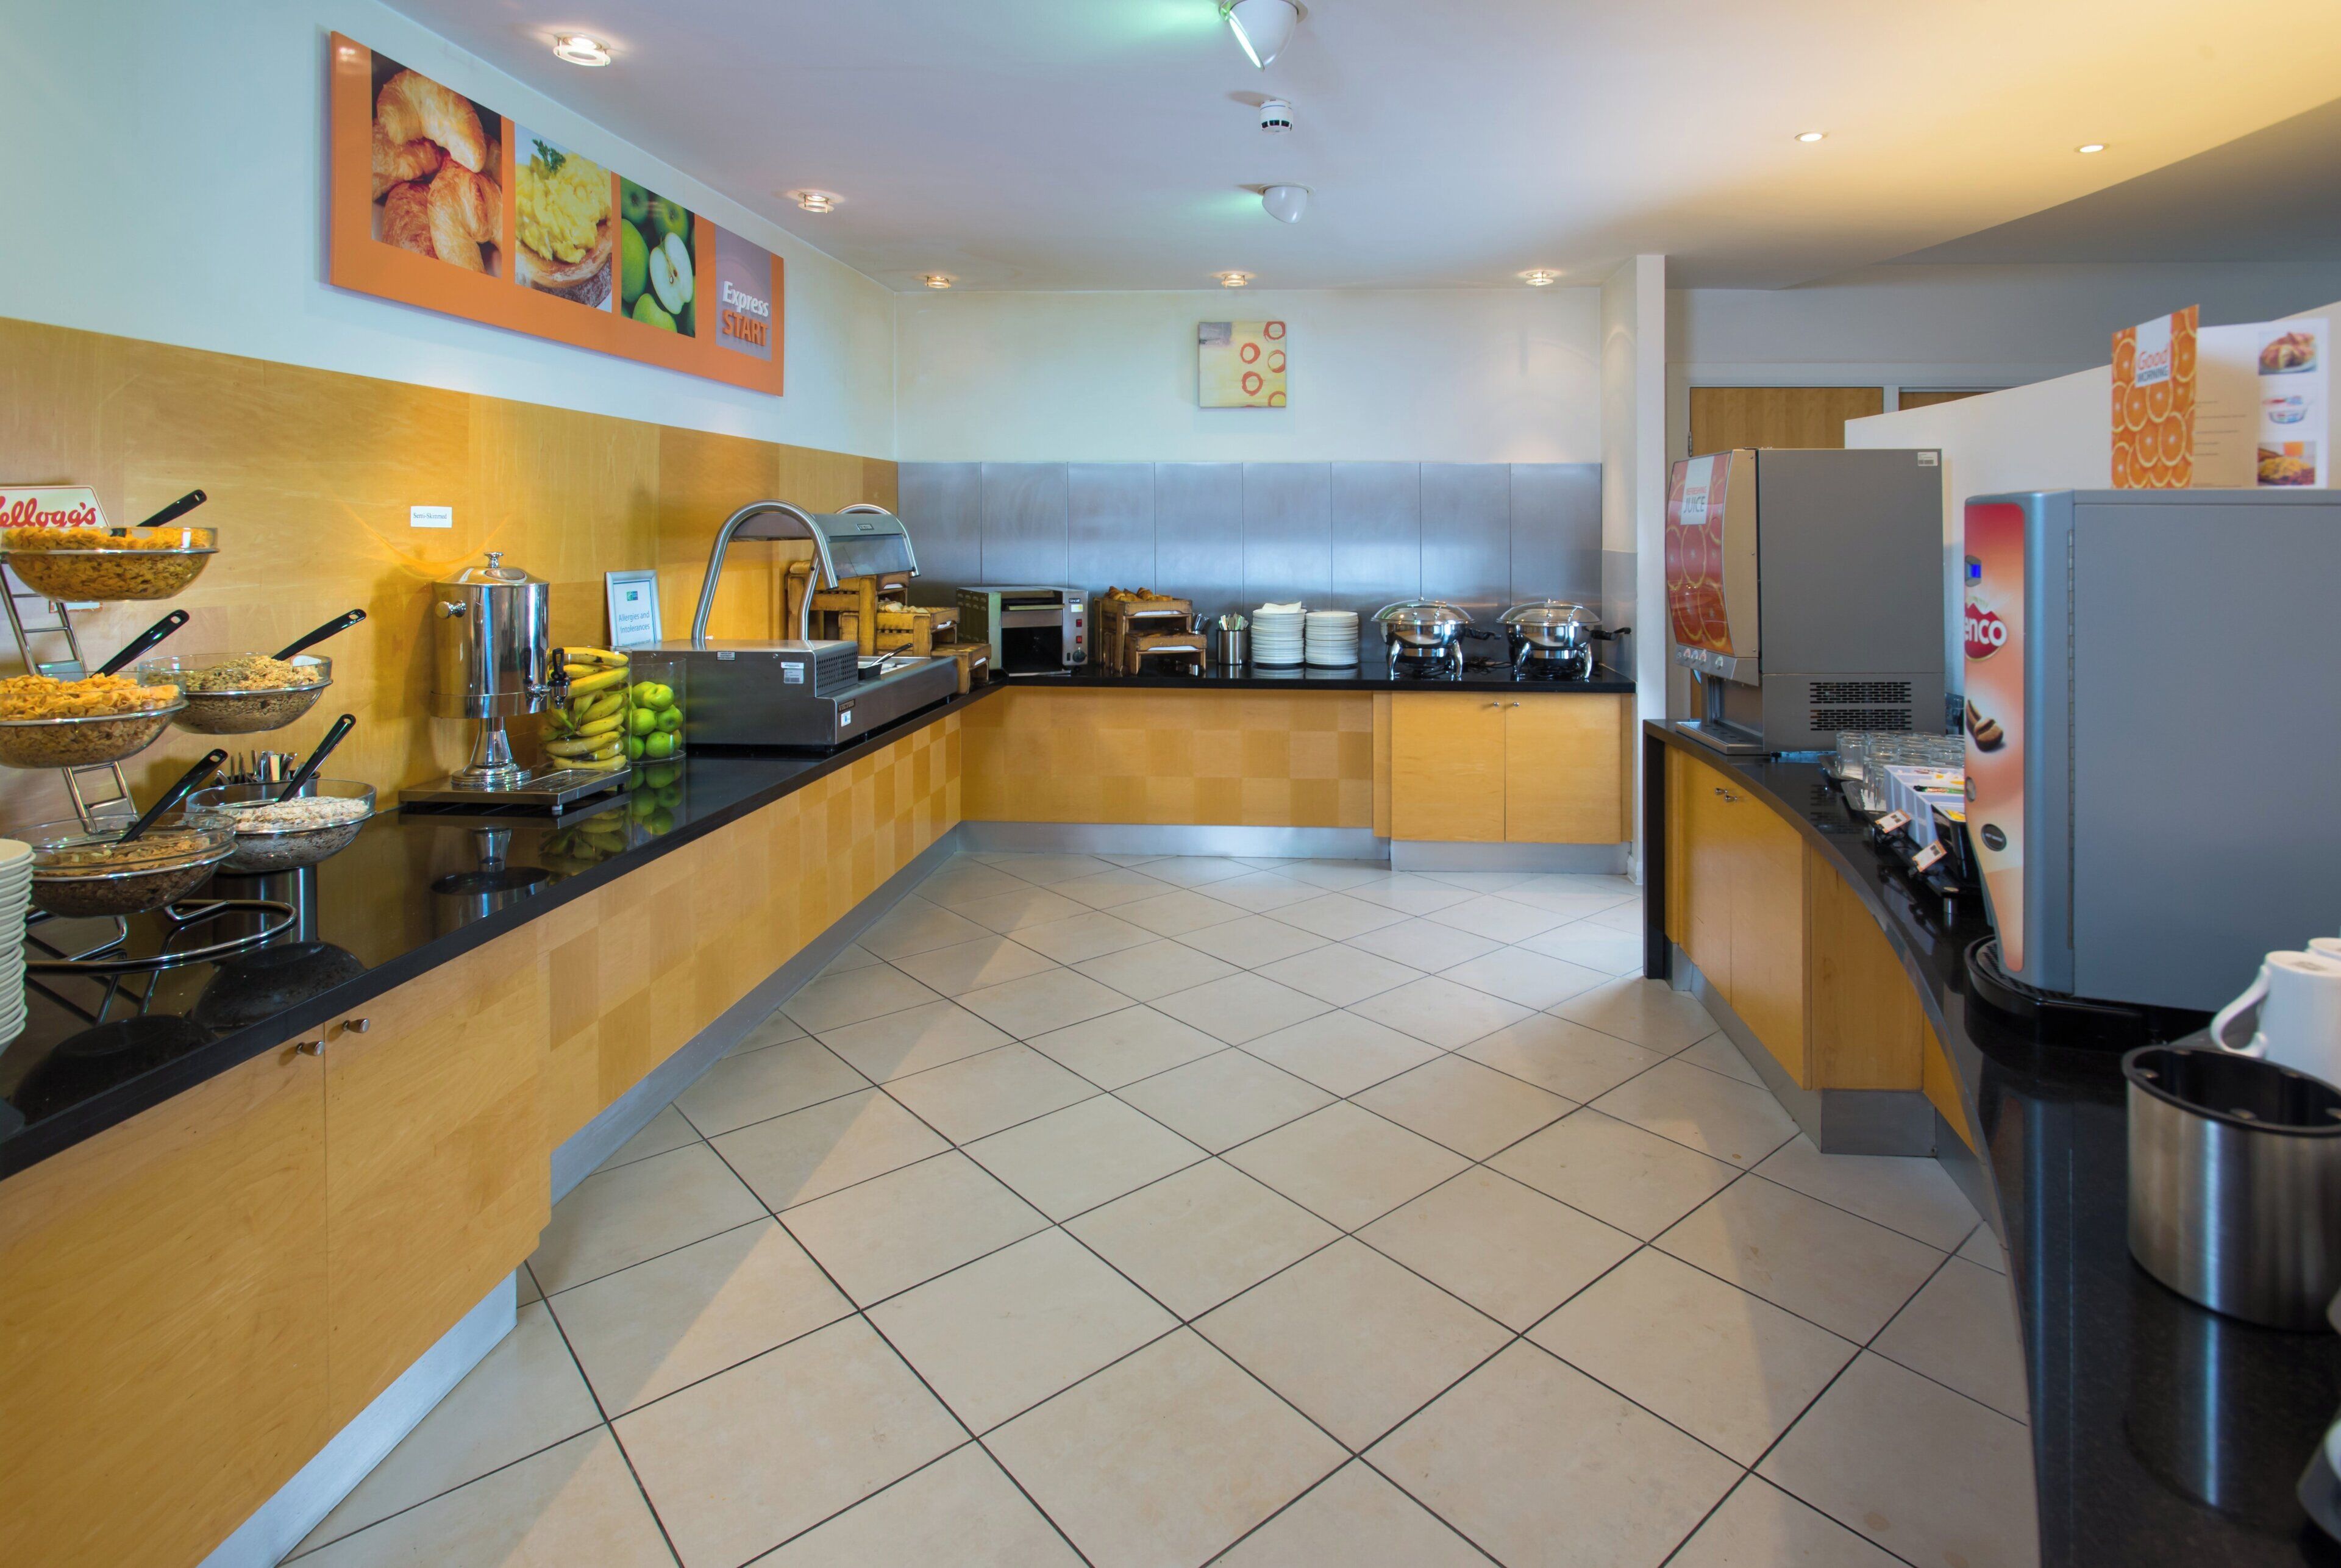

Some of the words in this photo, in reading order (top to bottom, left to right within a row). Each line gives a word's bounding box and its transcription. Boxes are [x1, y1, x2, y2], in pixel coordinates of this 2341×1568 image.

[722, 281, 769, 317] Express
[722, 309, 769, 346] START
[2137, 348, 2168, 370] Good
[2137, 365, 2168, 383] MORNING
[0, 496, 96, 527] ellogg's
[1683, 496, 1706, 513] JUICE
[619, 613, 640, 622] Allergies
[620, 623, 650, 633] Intolerances
